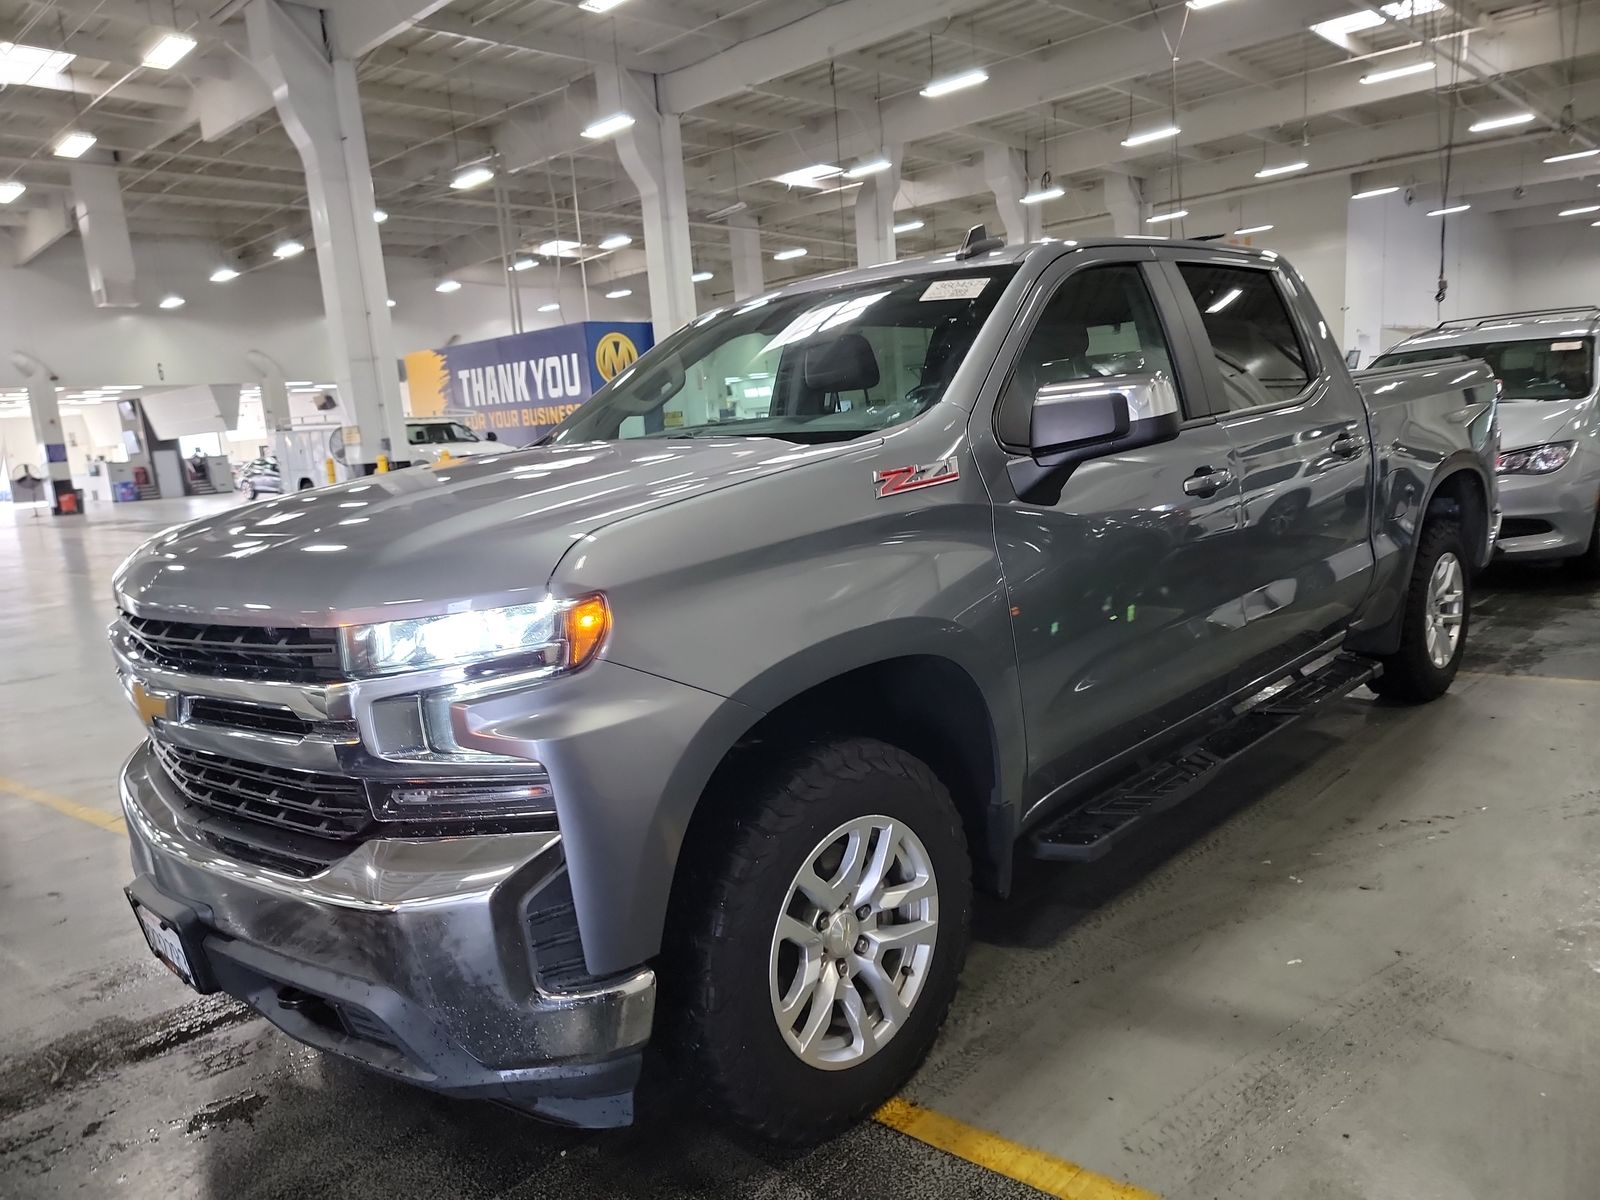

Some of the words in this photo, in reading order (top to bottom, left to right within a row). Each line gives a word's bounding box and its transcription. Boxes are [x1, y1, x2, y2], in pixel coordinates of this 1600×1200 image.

[458, 361, 530, 408] THANK
[528, 352, 582, 399] YOU
[487, 409, 520, 429] YOUR
[521, 403, 582, 426] BUSINES
[872, 455, 960, 500] Z71
